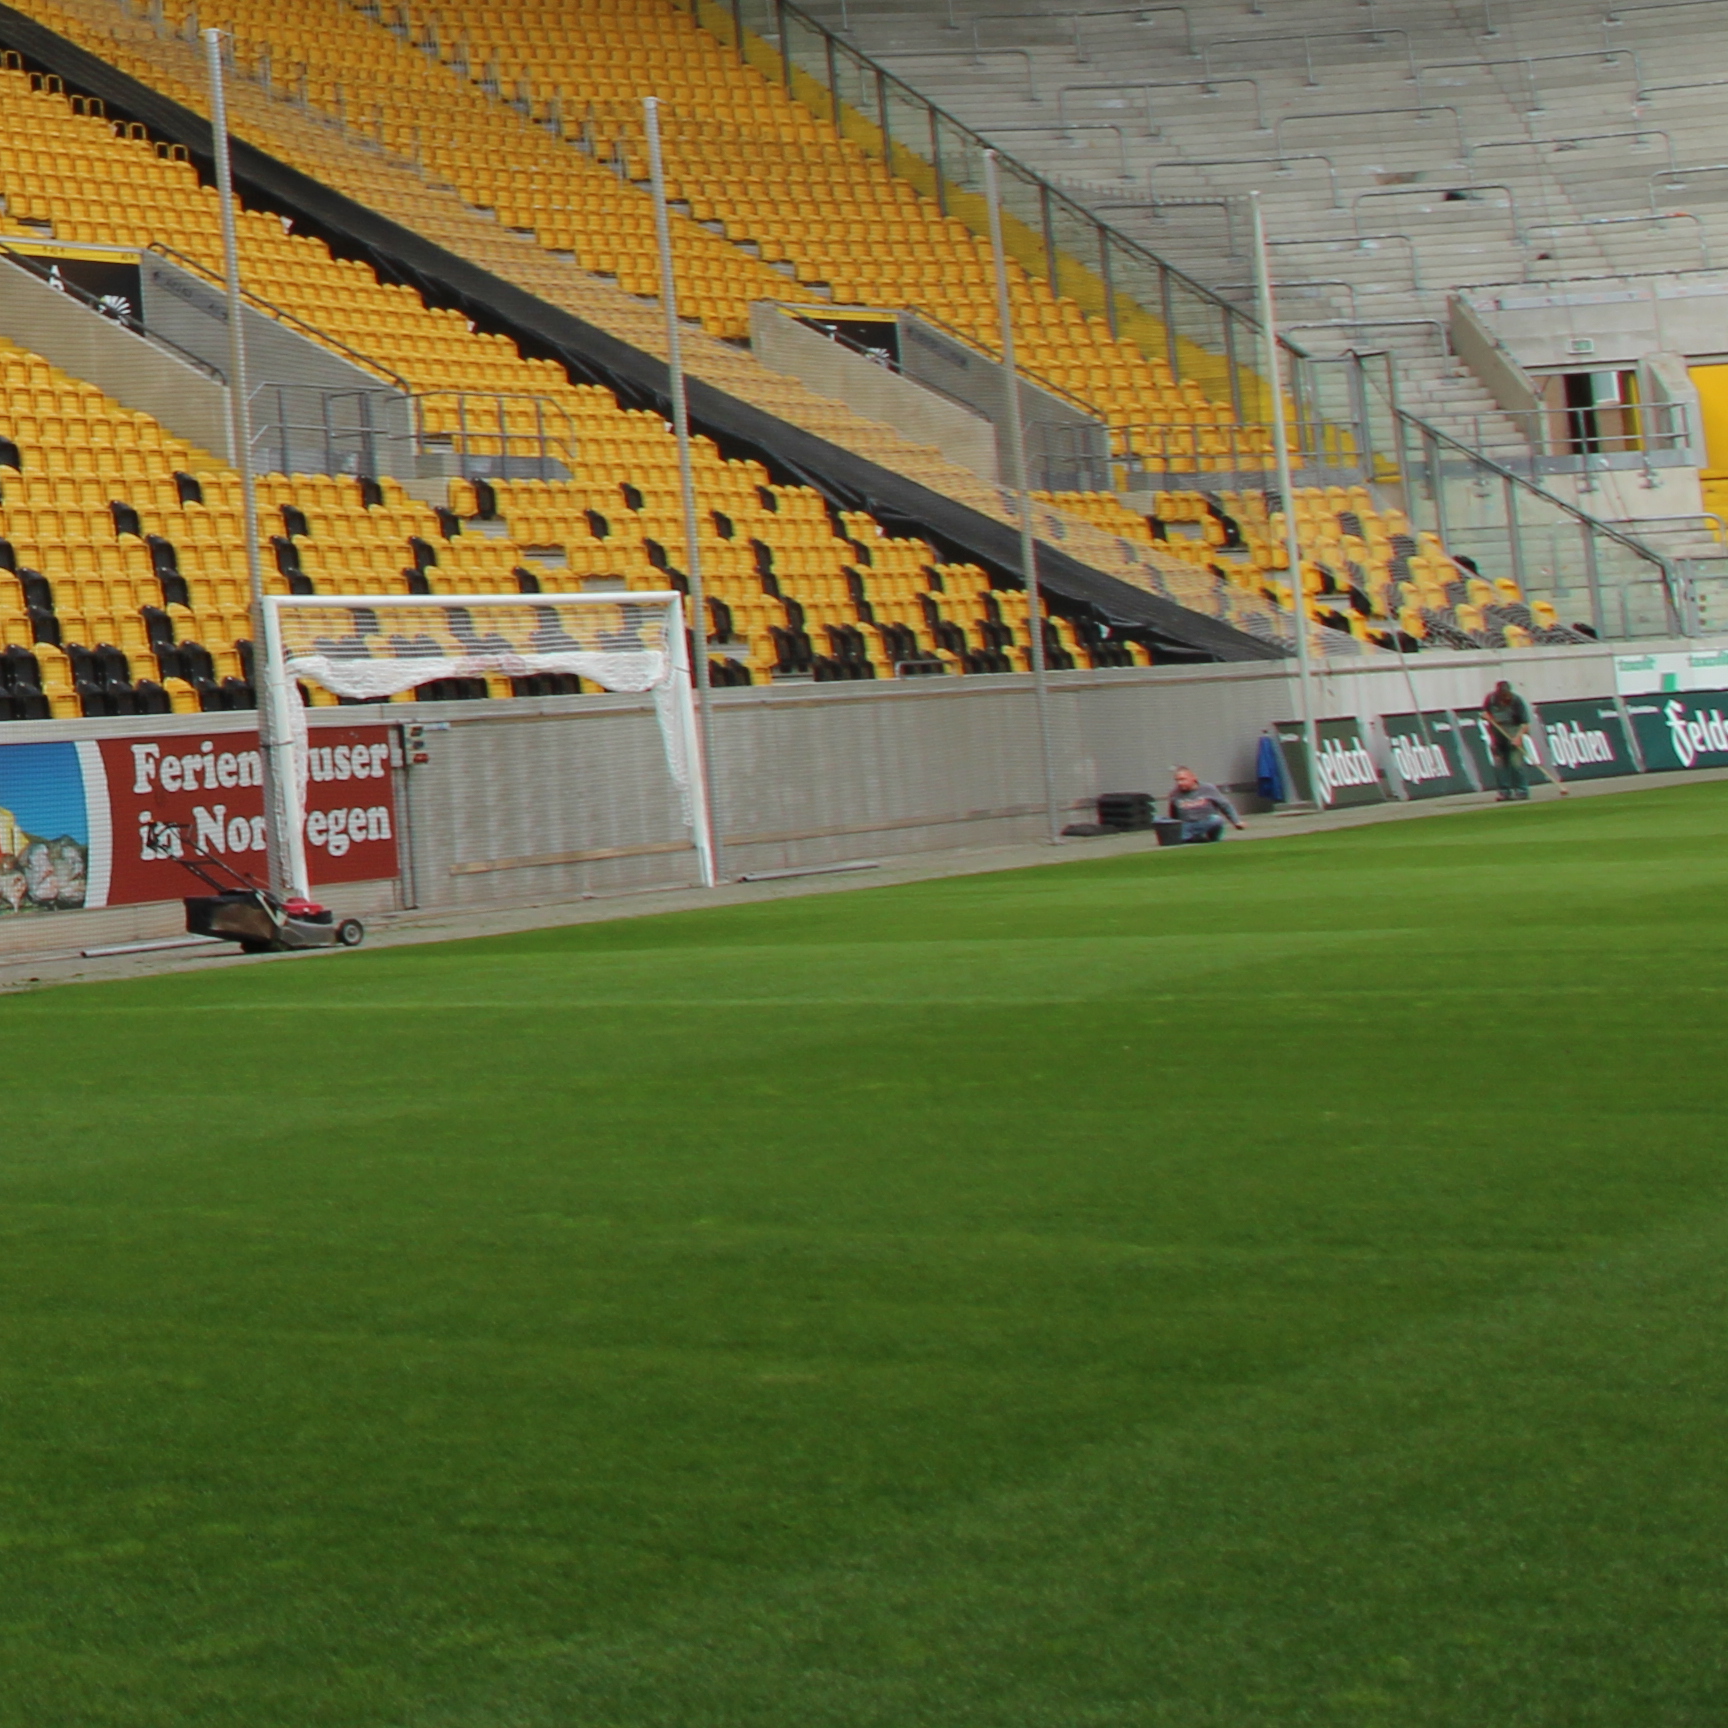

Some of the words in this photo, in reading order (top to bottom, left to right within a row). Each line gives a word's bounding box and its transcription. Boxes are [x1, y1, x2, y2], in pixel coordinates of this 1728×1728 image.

[130, 741, 389, 794] Ferienuser
[138, 810, 184, 860] in
[192, 803, 392, 856] Noregen
